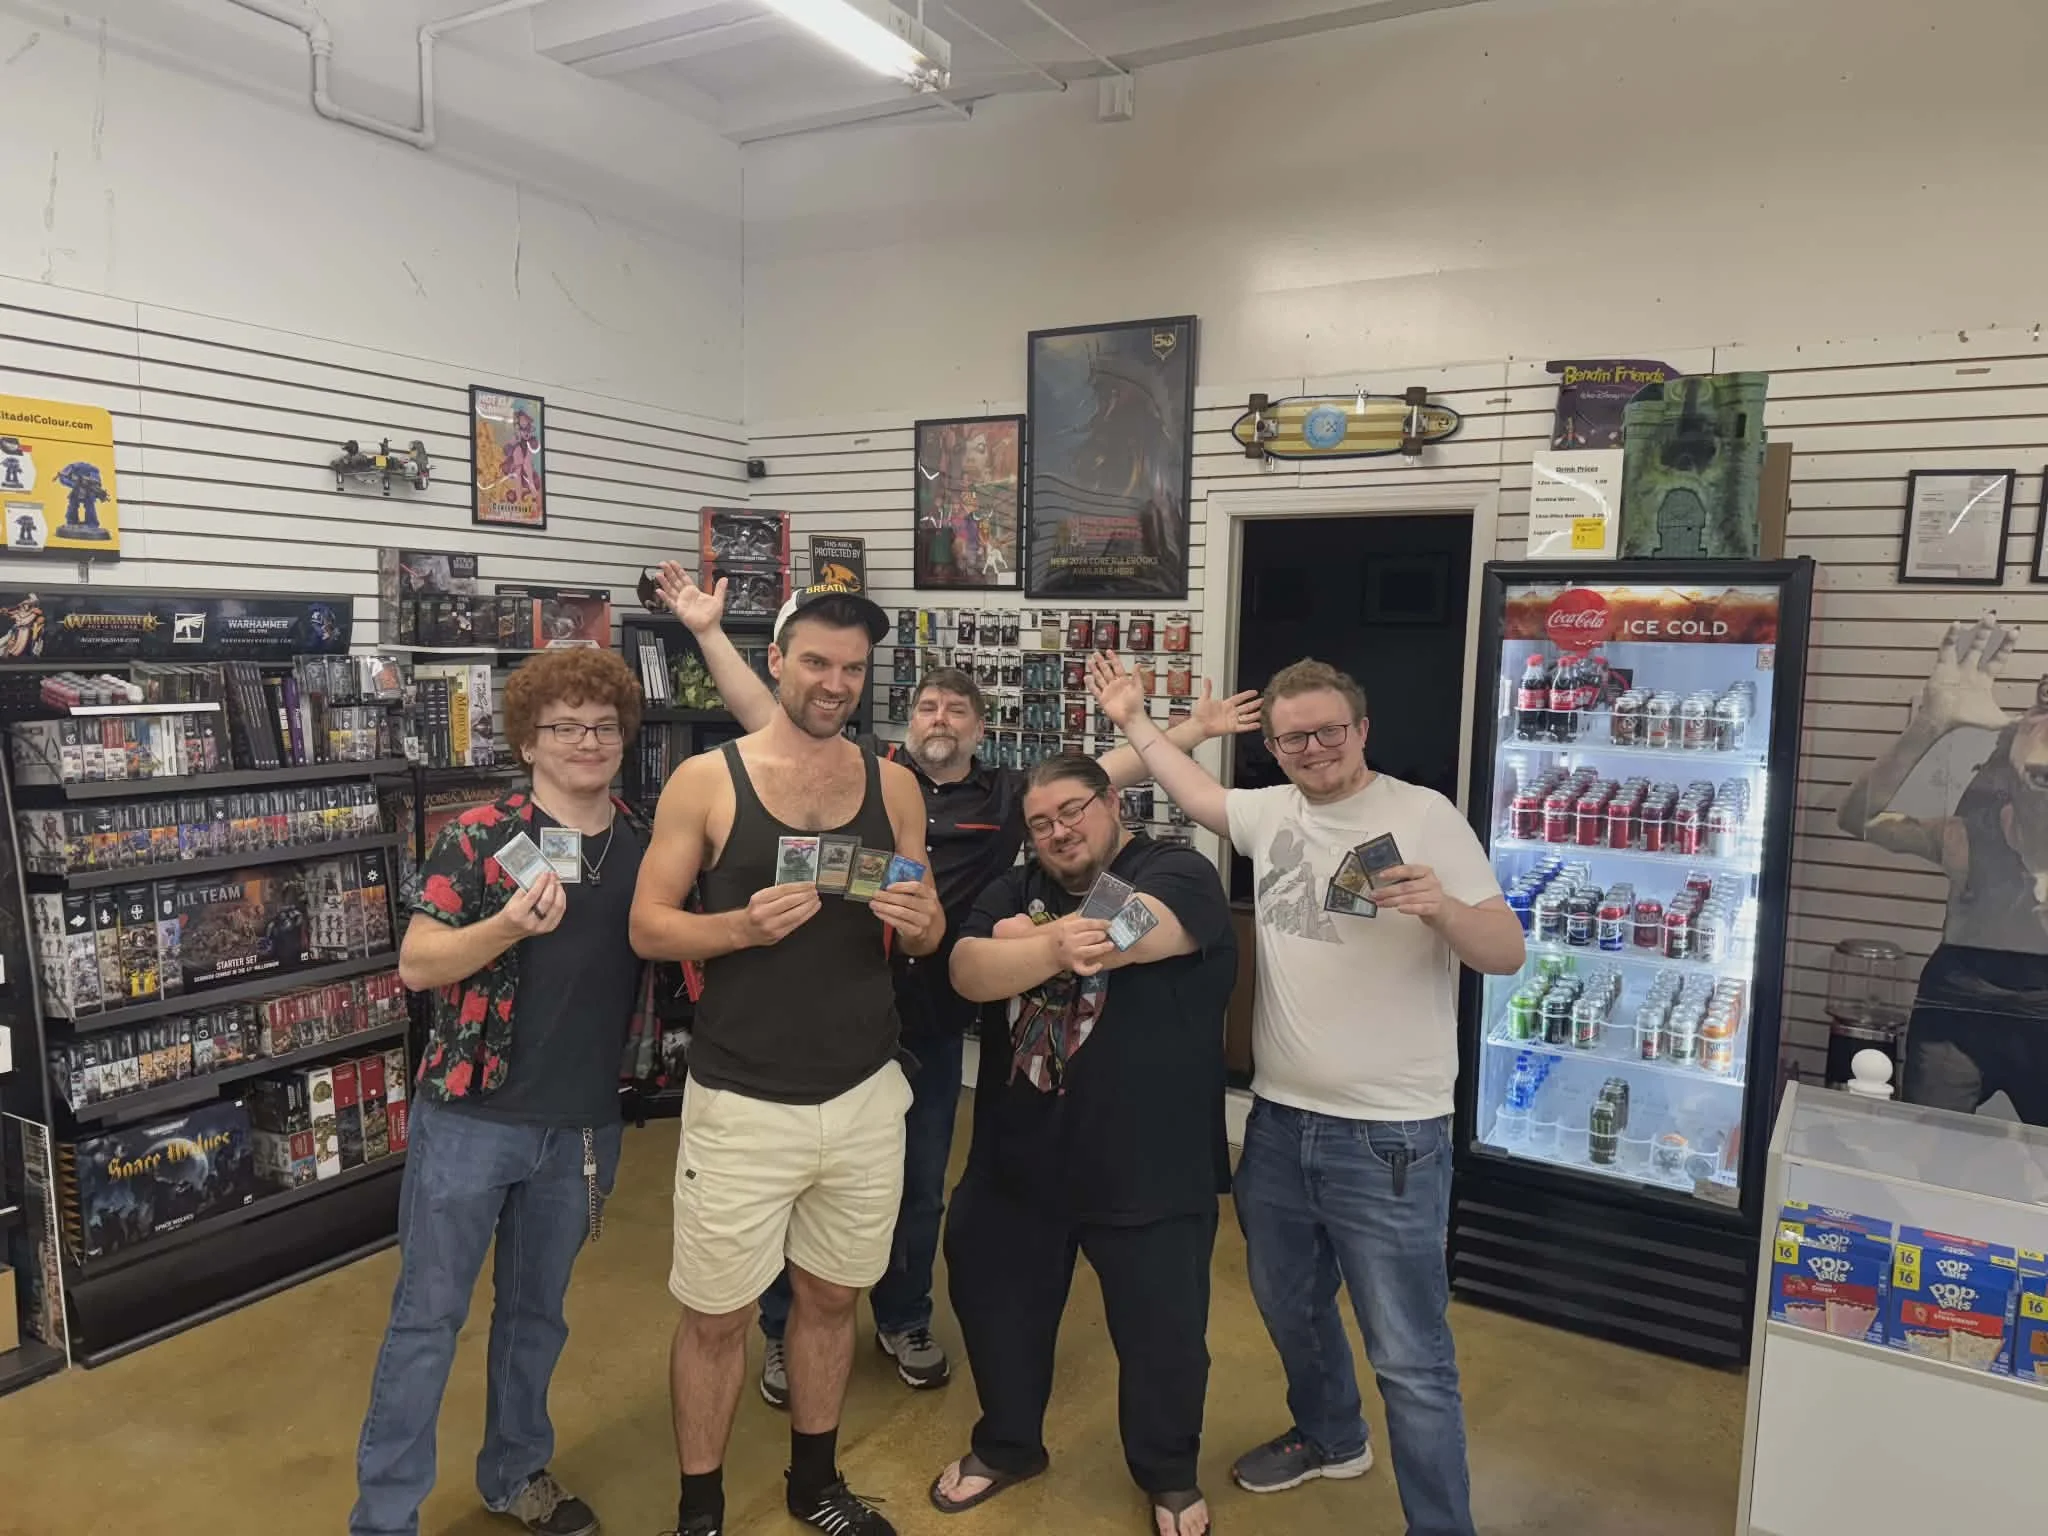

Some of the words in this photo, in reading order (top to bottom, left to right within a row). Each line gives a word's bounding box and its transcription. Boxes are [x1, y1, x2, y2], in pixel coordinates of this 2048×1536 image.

[1564, 366, 1613, 385] Bendin'
[1615, 365, 1665, 384] Friends
[0, 411, 94, 430] itadelColour.com
[815, 545, 851, 558] PROTECTED
[852, 549, 861, 559] BY
[227, 620, 289, 629] WARHAMMER
[1548, 608, 1609, 630] Coca-Cola
[1623, 619, 1659, 635] ICE
[1666, 620, 1728, 636] COLD
[176, 891, 198, 907] ILL
[200, 885, 241, 904] TEAM
[216, 957, 244, 971] STARTER
[246, 953, 257, 965] SET
[1779, 1246, 1793, 1258] 16
[1900, 1250, 1914, 1264] 16
[1899, 1270, 1914, 1284] 16
[2028, 1299, 2044, 1314] 16
